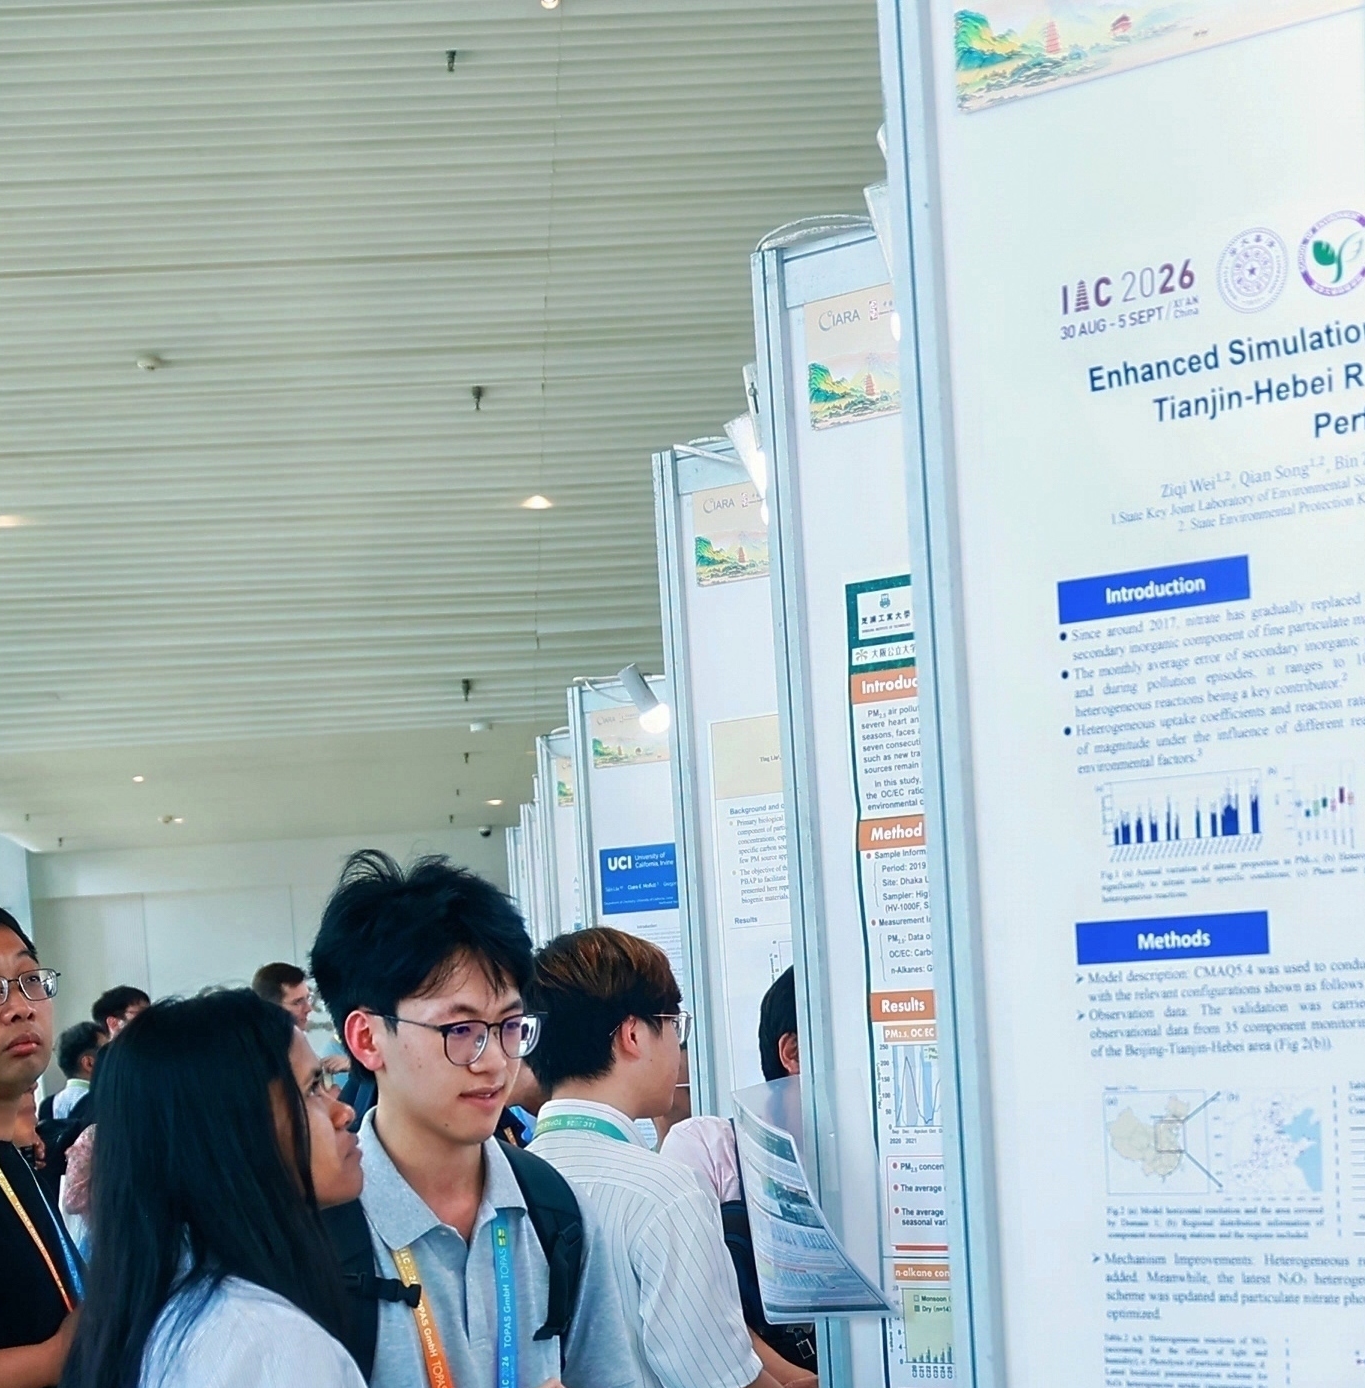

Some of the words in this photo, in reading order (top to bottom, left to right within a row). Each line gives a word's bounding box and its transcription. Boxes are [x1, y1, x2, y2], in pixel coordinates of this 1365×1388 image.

[1122, 258, 1194, 302] 2026
[1174, 308, 1199, 318] China
[1061, 324, 1076, 340] 30
[1078, 318, 1106, 336] AUG
[1118, 314, 1126, 328] 5
[1129, 306, 1164, 326] SEPT
[1088, 344, 1219, 393] Enhanced
[1153, 368, 1334, 423] Tianjin-Hebei
[1161, 483, 1187, 498] Ziqi
[1240, 471, 1272, 488] Qian
[1335, 456, 1358, 470] Bin
[1106, 577, 1206, 604] Introduction
[888, 707, 897, 715] air
[862, 720, 885, 729] severe
[888, 718, 907, 726] heart
[862, 731, 894, 740] seasons,
[896, 728, 915, 737] faces
[863, 743, 884, 752] seven
[864, 754, 880, 763] such
[894, 751, 908, 759] new
[864, 765, 892, 774] sources
[894, 762, 919, 771] remain
[884, 778, 897, 786] this
[881, 789, 904, 798] OC/EC
[868, 799, 917, 810] environmental
[730, 805, 766, 815] Background
[737, 819, 756, 827] Primary
[758, 815, 783, 823] biological
[737, 828, 765, 836] component
[871, 822, 922, 841] Method
[635, 853, 658, 861] University
[875, 850, 900, 859] Sample
[607, 855, 632, 871] UCI
[882, 864, 907, 872] Period:
[909, 862, 926, 870] 2019
[900, 877, 922, 885] Dhaka
[883, 892, 914, 900] Sampler:
[886, 903, 922, 912] (HV-1000F,
[879, 916, 925, 926] Measurement
[908, 933, 923, 941] Data
[1137, 929, 1211, 950] Methods
[891, 965, 924, 974] n-Alkanes:
[882, 997, 925, 1013] Results
[901, 1184, 913, 1192] The
[915, 1185, 942, 1193] average
[902, 1208, 914, 1216] The
[916, 1208, 944, 1217] average
[902, 1218, 932, 1226] seasonal
[499, 1248, 509, 1278] TOPAS
[896, 1268, 932, 1277] n-alkane
[503, 1285, 511, 1313] GmbH
[417, 1301, 429, 1326] OPAS
[423, 1329, 438, 1358] GmbH
[503, 1316, 511, 1348] TOPAS
